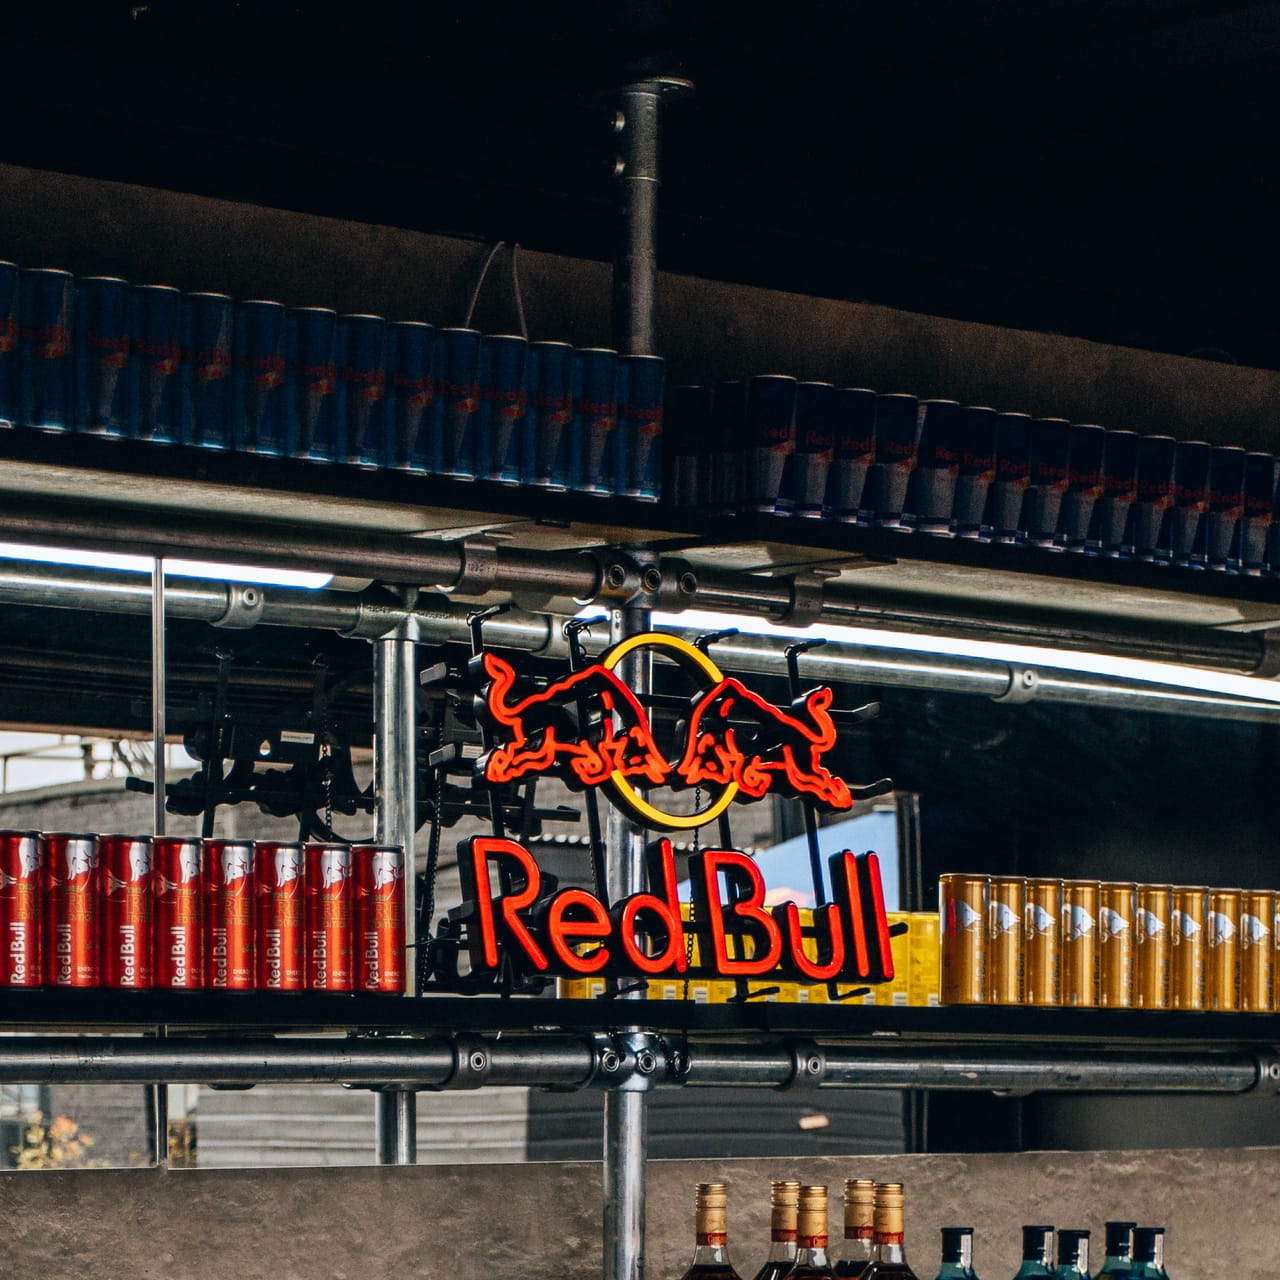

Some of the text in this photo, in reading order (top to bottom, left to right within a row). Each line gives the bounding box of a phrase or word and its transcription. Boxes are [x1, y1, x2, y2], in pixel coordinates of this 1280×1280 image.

[471, 836, 895, 980] Red Bull
[10, 922, 25, 984] Red Bull
[57, 924, 72, 984] Red Bull
[120, 925, 135, 986] Red Bull
[171, 926, 186, 986] Red Bull
[213, 928, 227, 987] Red Bull
[266, 929, 281, 988] Red Bull
[313, 931, 327, 988] Red Bull
